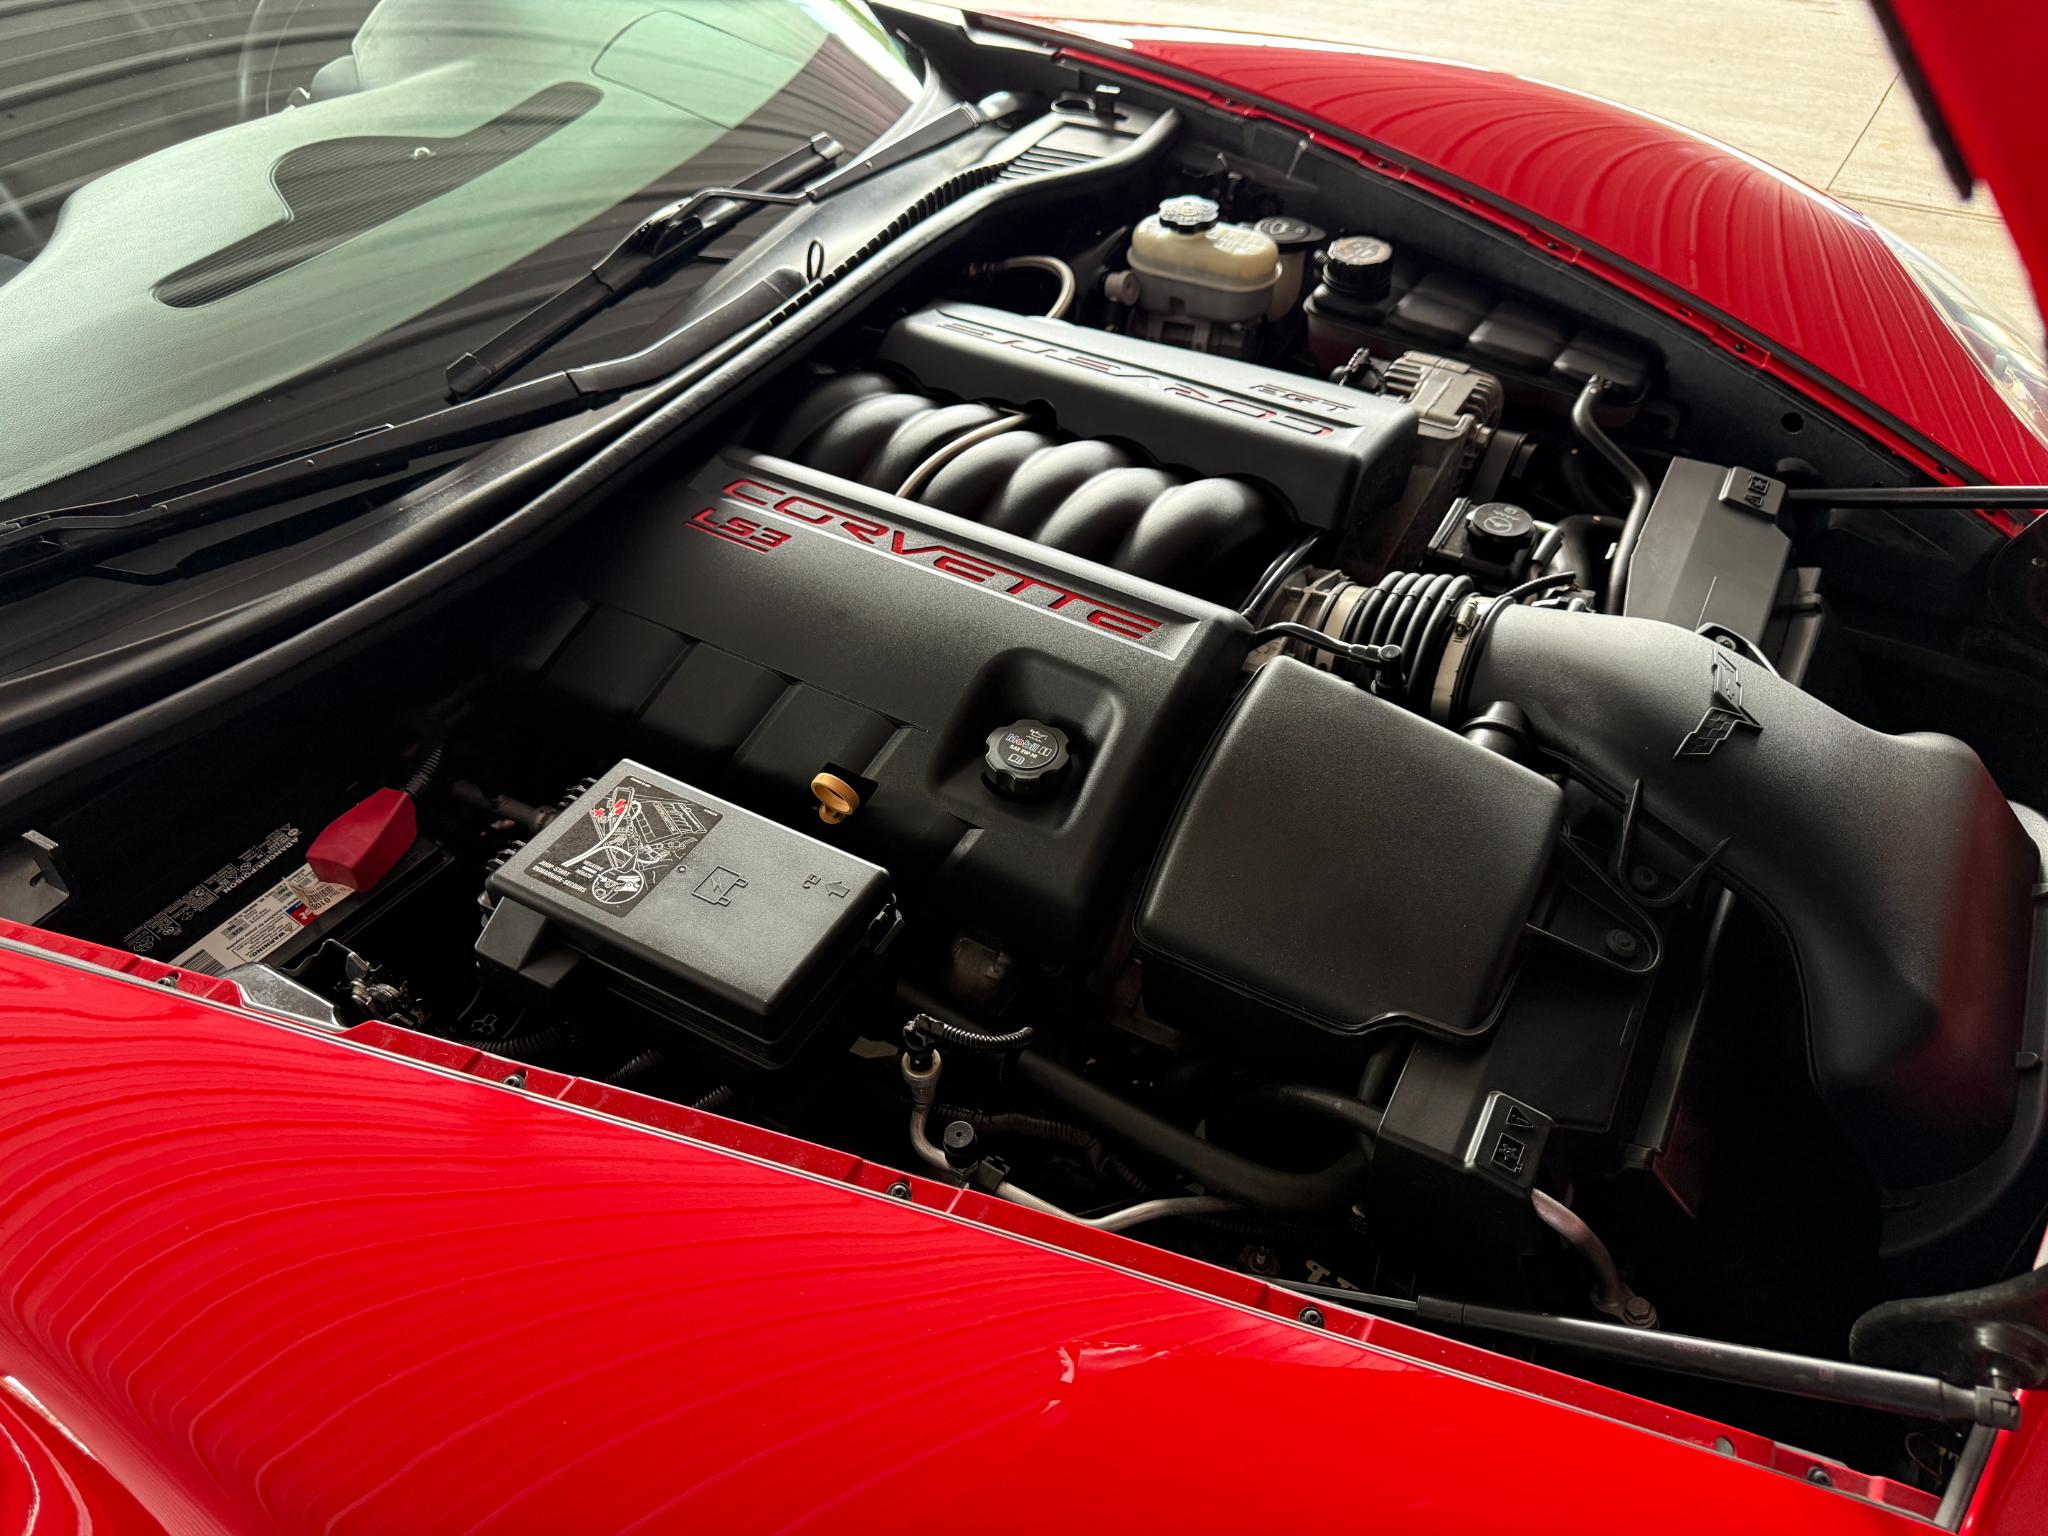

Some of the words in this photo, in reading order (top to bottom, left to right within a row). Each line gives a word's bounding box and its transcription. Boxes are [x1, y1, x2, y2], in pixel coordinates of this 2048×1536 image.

[689, 507, 793, 548] LS3
[723, 479, 1163, 640] CORVETTE
[1005, 733, 1040, 753] Mobil
